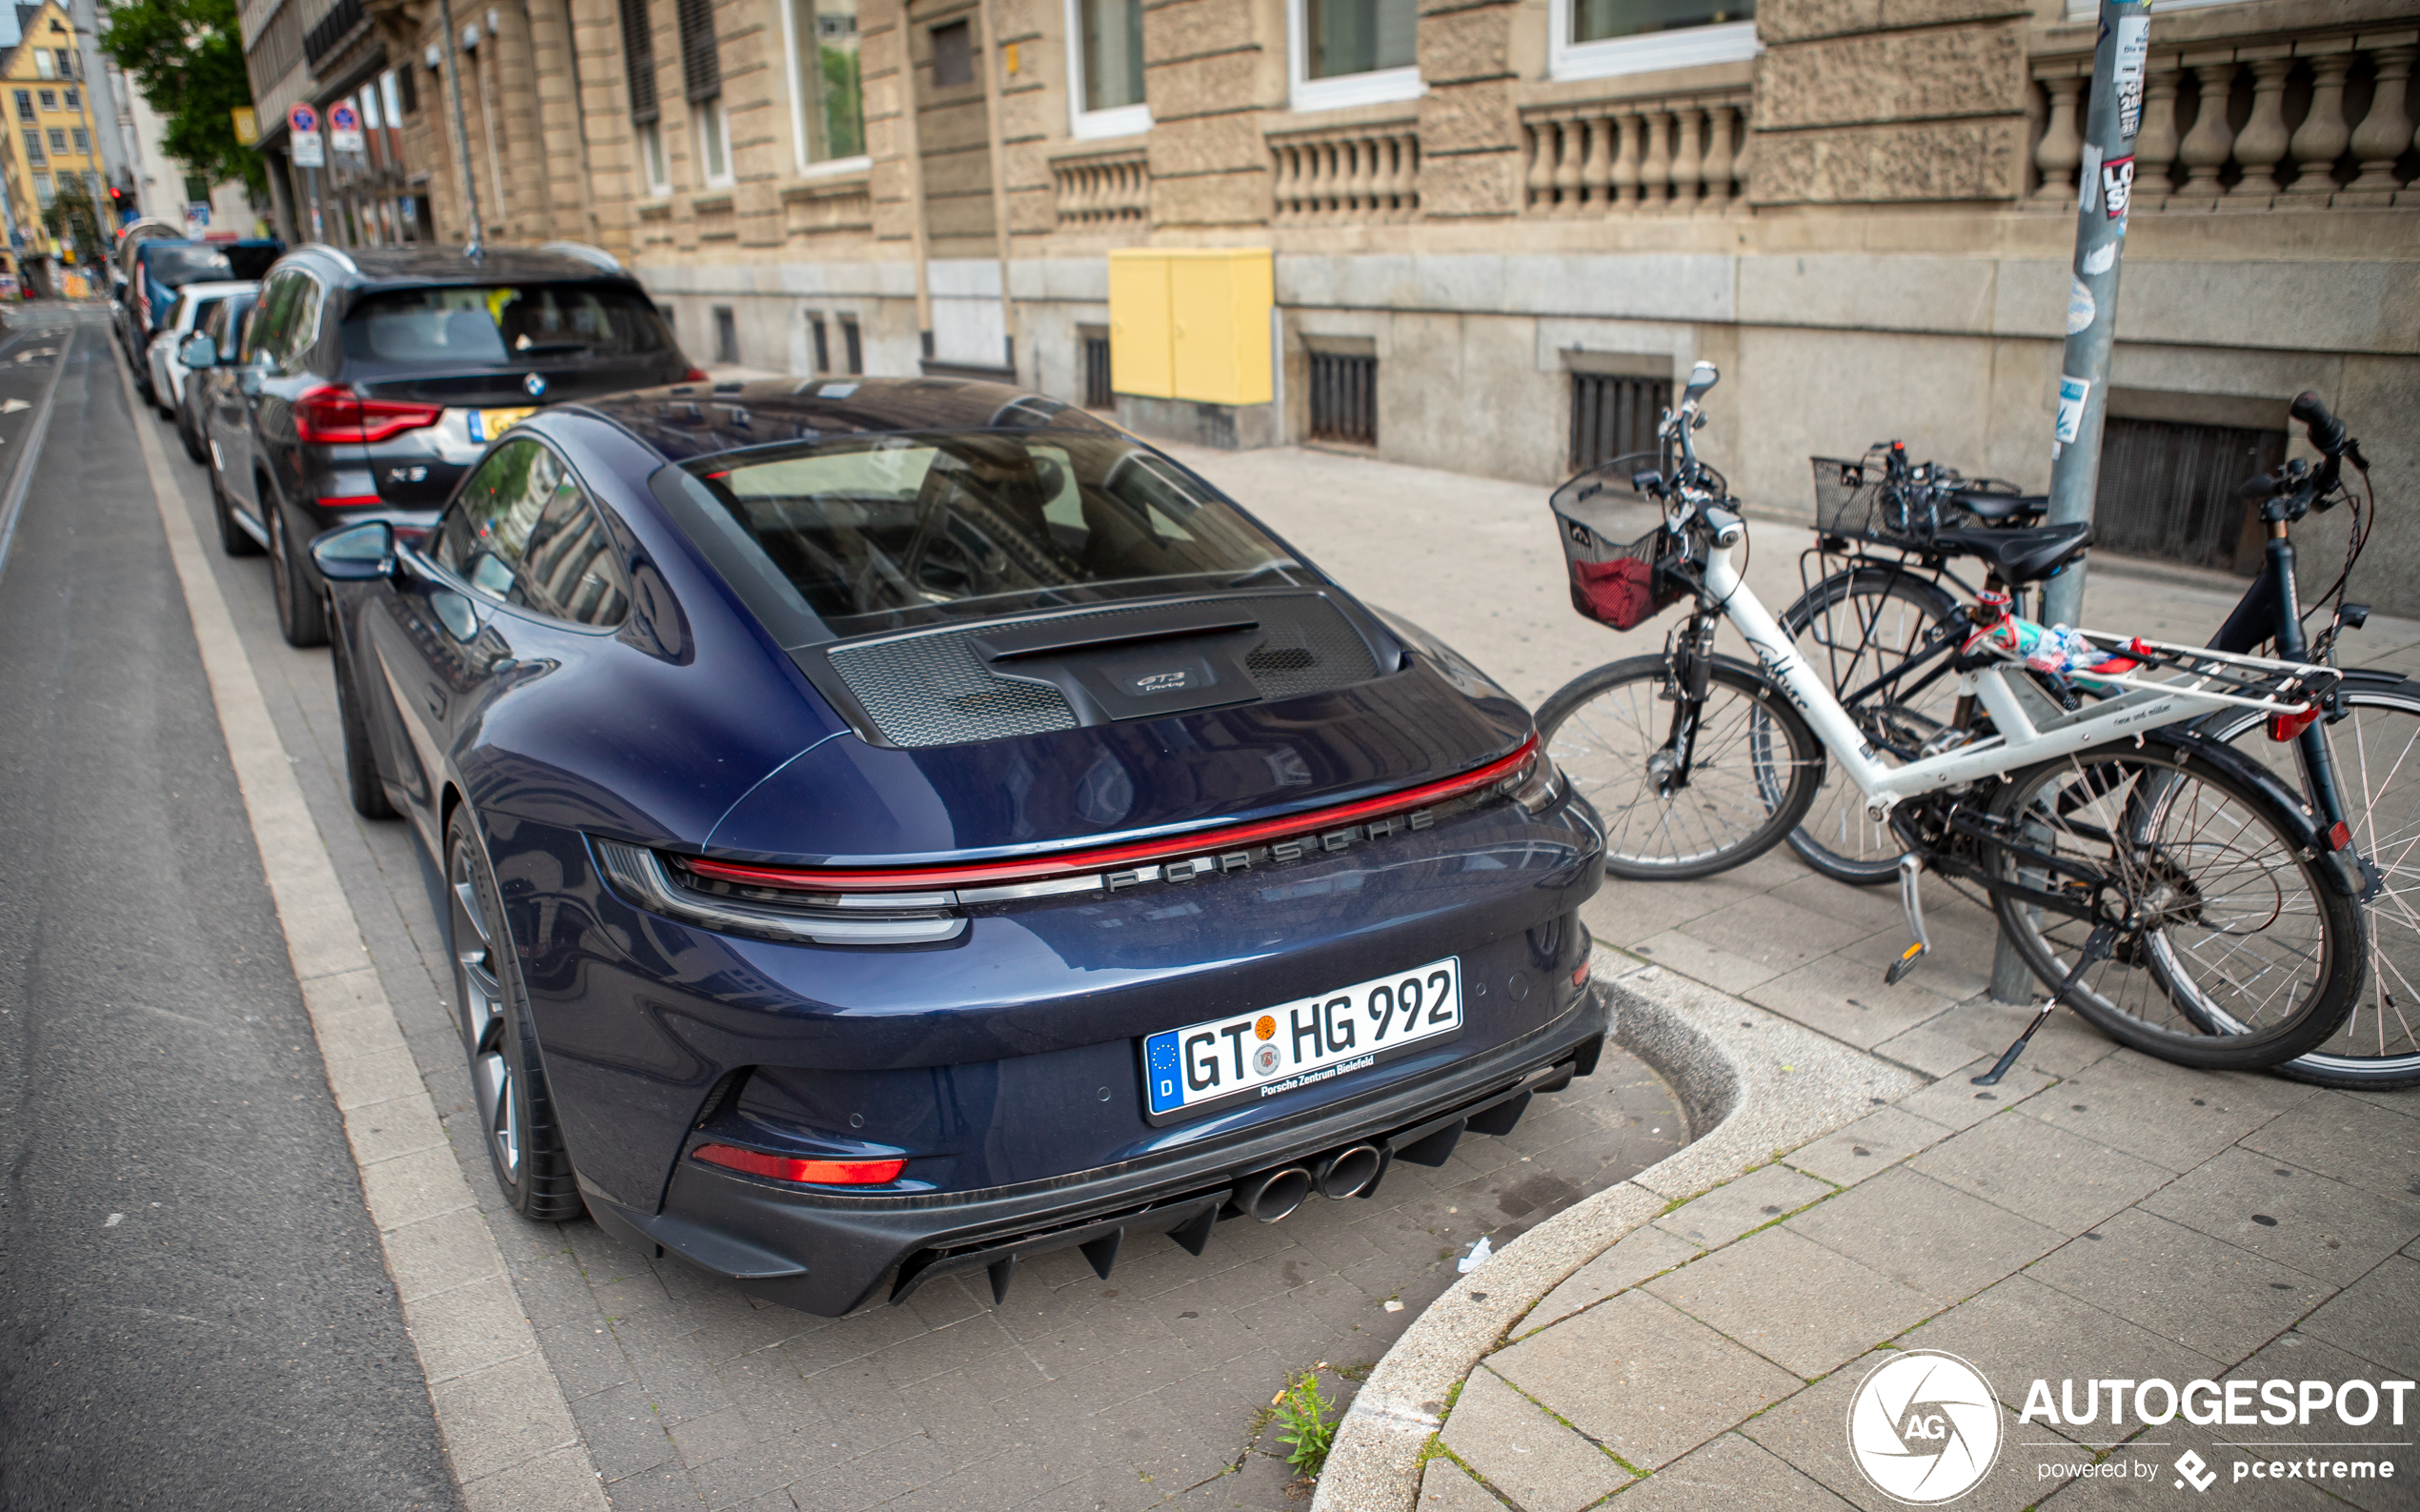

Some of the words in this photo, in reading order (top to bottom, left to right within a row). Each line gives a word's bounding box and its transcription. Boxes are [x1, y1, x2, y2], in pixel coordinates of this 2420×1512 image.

[1137, 672, 1185, 686] GT3
[1107, 810, 1435, 893] PORSCHE
[1184, 1020, 1252, 1091] GT
[1290, 996, 1356, 1064] HG
[1368, 969, 1453, 1041] 992
[1160, 1079, 1173, 1098] D
[1260, 1079, 1299, 1098] Porsche
[1298, 1068, 1336, 1086] Zentrum
[1336, 1055, 1375, 1075] Bielefeld
